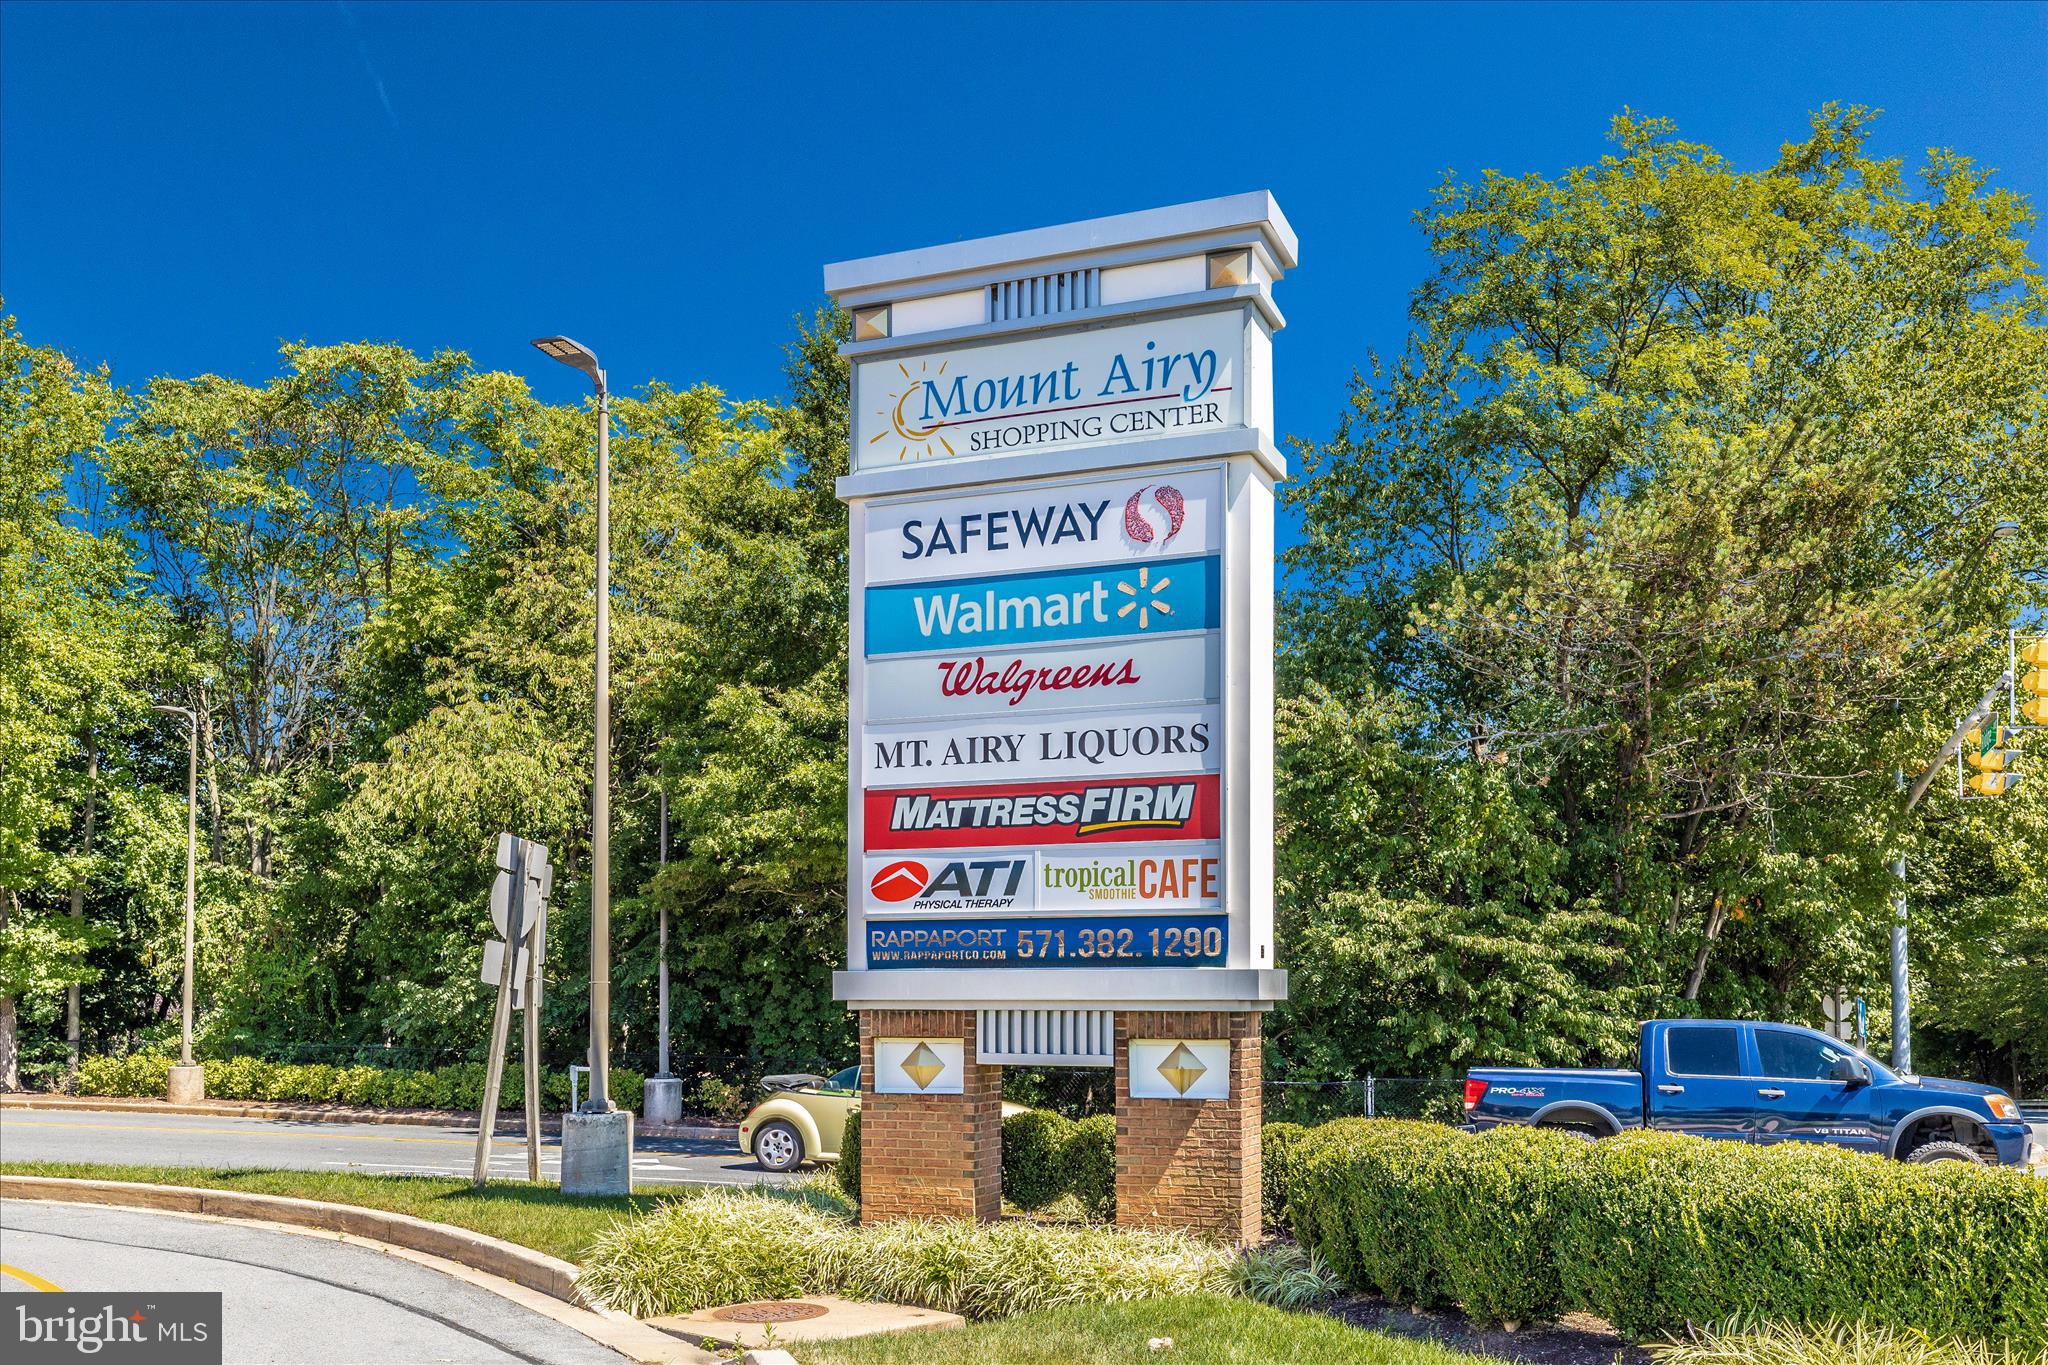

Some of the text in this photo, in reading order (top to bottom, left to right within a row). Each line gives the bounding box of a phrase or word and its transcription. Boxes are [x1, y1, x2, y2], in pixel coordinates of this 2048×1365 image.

[918, 341, 1217, 421] Mount Airy
[970, 402, 1223, 451] SHOPPING CENTER
[901, 500, 1111, 559] SAFEWAY
[913, 580, 1109, 637] Walmart
[938, 656, 1141, 706] Walgreens
[874, 723, 1210, 769] MT. AIRY LIQUORS
[920, 860, 1026, 898] ATI
[1044, 860, 1136, 892] tropical
[1089, 888, 1136, 900] SMOOTHIE
[1139, 858, 1218, 899] CAFE
[913, 898, 1014, 909] PHYSICAL THERAPY
[871, 929, 1007, 948] RAPPAPORT
